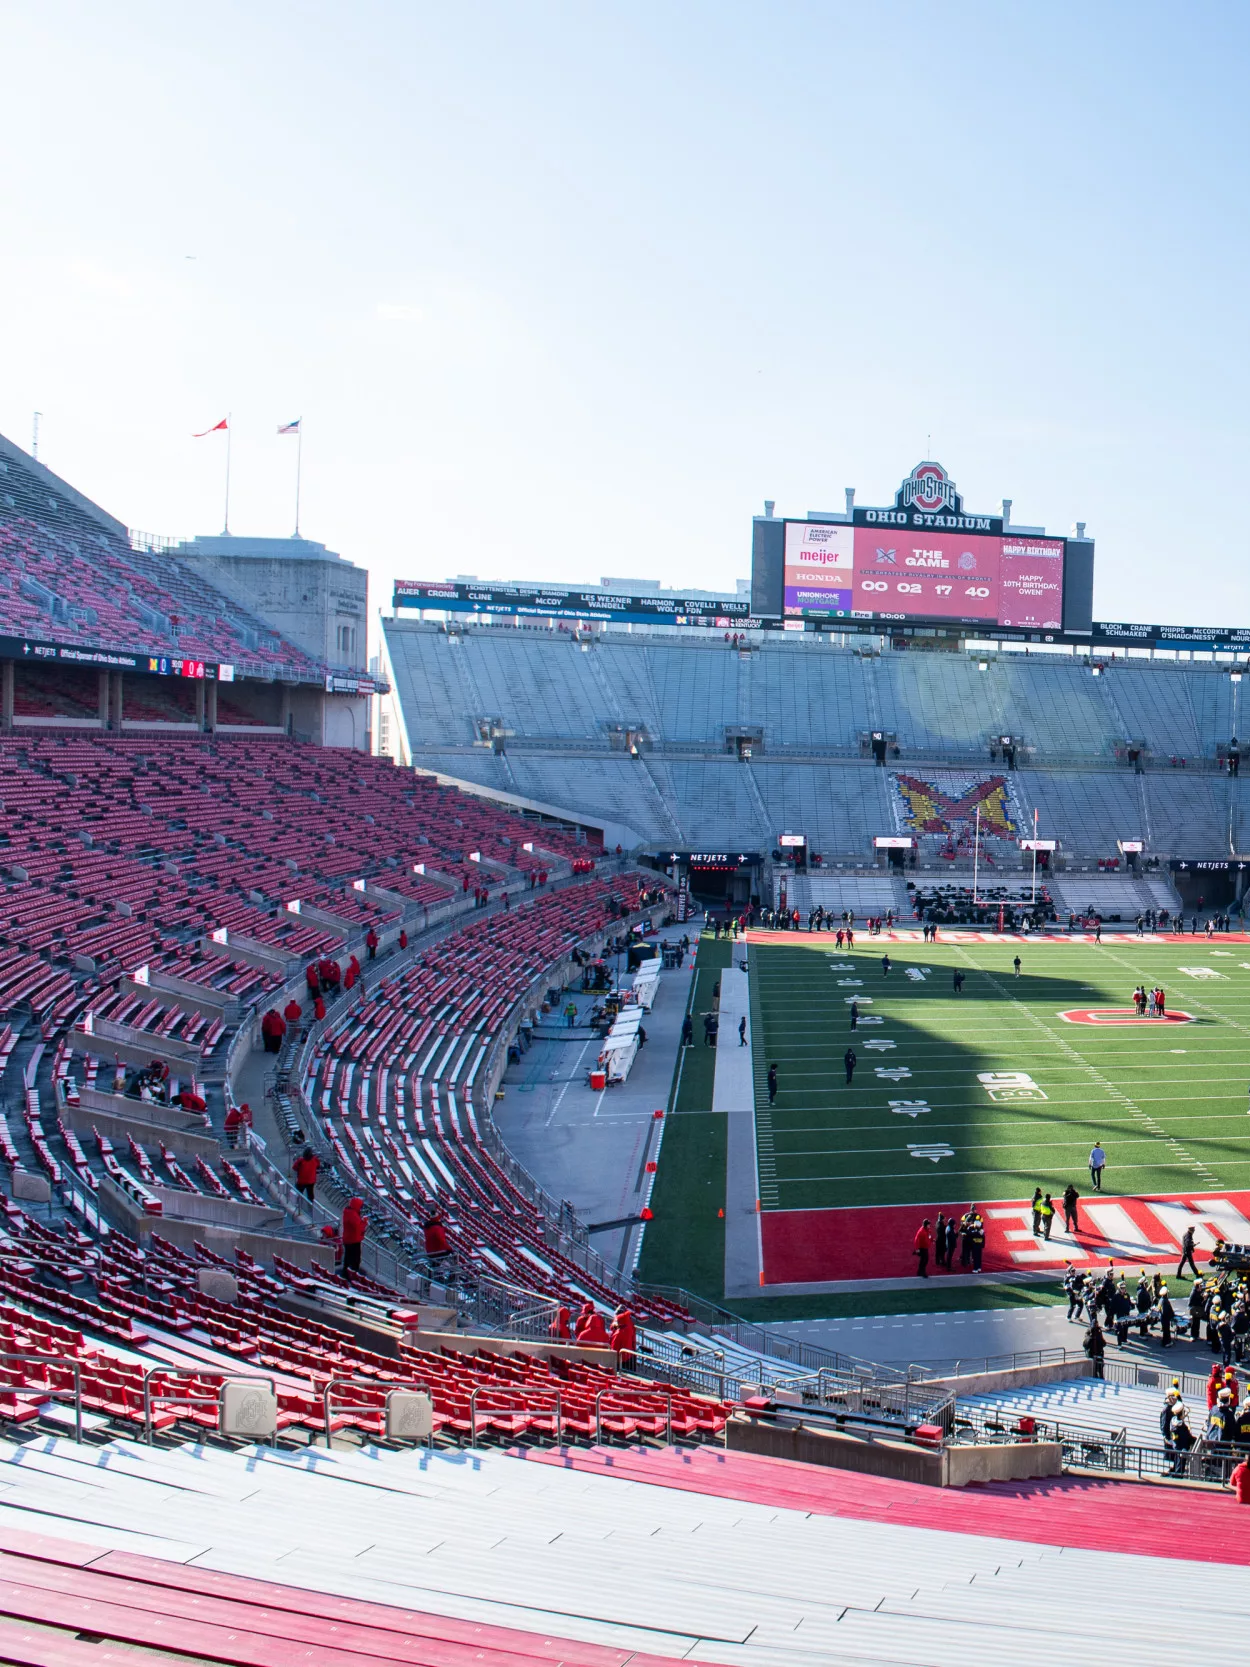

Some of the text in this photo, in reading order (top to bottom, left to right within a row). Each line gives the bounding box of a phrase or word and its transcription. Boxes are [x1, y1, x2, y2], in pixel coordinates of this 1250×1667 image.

[865, 510, 991, 531] OHIO STADIUM
[912, 549, 943, 559] THE
[1003, 544, 1061, 557] HAPPY BIRTHDAY
[800, 549, 840, 564] meijer
[905, 557, 950, 569] GAME
[795, 573, 843, 582] HONDA
[861, 580, 990, 598] 00 02 17 40
[1018, 588, 1043, 596] OWEN!
[397, 588, 493, 601] AUER CRONIN CLINE
[541, 590, 569, 598] DIAMOND
[535, 597, 562, 606] McCOY
[581, 594, 632, 604] LES WEXNER
[640, 598, 675, 607] HARMON
[588, 601, 626, 610] WANDELL
[656, 605, 684, 613] WOLFE
[684, 600, 716, 609] COVELLI
[721, 602, 748, 610] WELLS
[879, 612, 906, 620] 90:00
[1105, 629, 1148, 638] SCHUMAKER
[1130, 624, 1153, 632] CRANE
[1160, 626, 1185, 634] PHIPPS
[1161, 632, 1216, 641] O'SHAUGHNESSY
[34, 646, 56, 658] NETJETS
[690, 854, 728, 862] NETJETS
[1196, 861, 1229, 870] NETJETS
